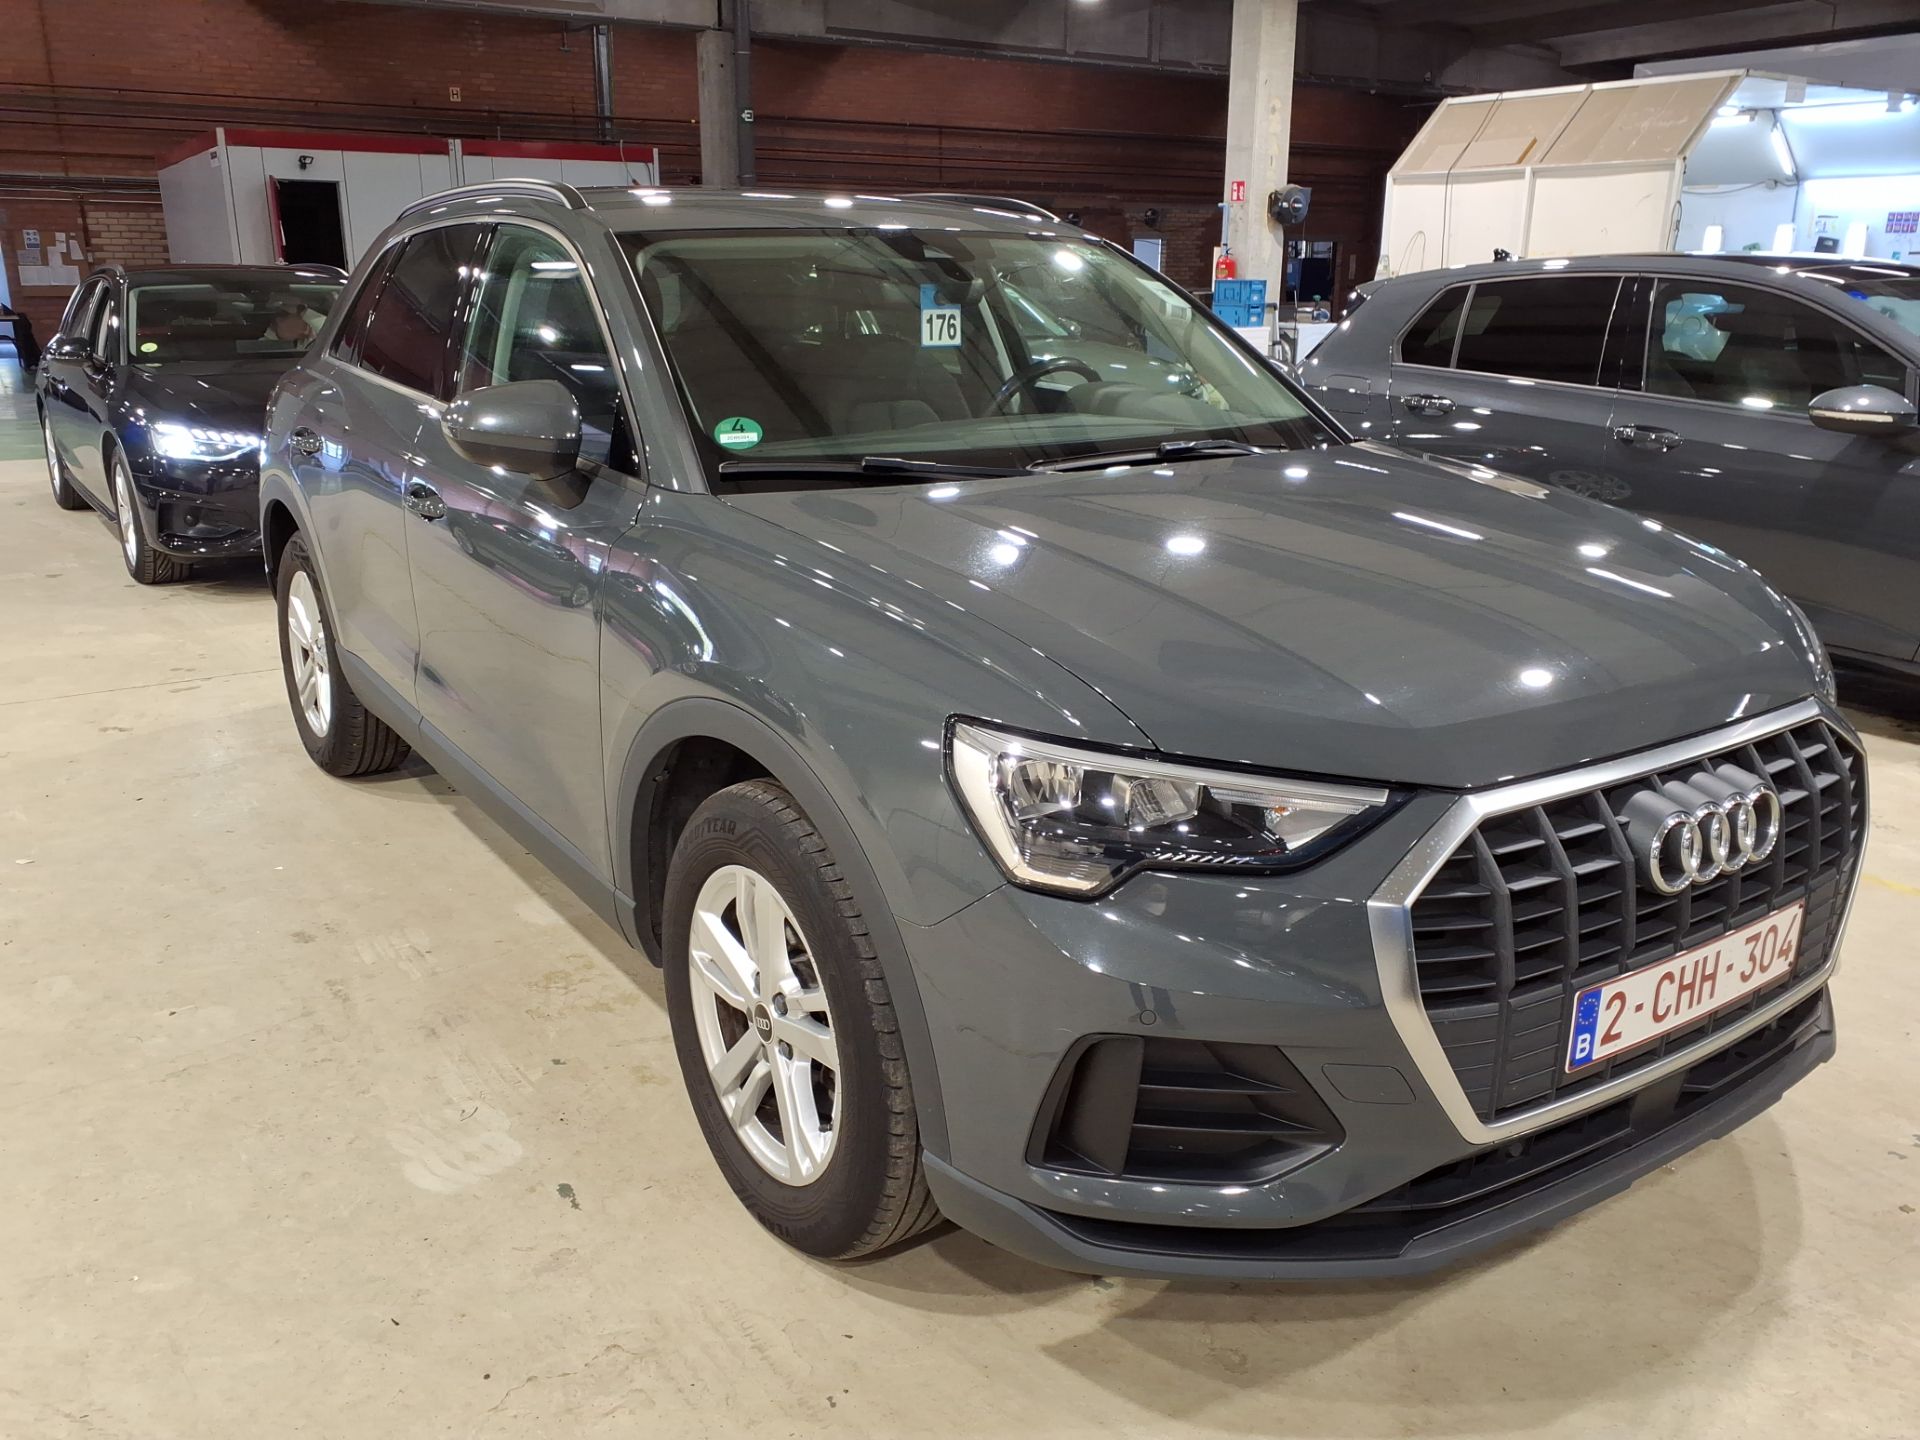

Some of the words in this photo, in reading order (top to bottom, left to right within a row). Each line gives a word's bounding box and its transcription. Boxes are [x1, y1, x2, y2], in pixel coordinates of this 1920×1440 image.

[926, 313, 957, 341] 176
[731, 418, 746, 433] 4
[1600, 912, 1799, 1047] 2-CHH-304
[1575, 1032, 1591, 1060] B
